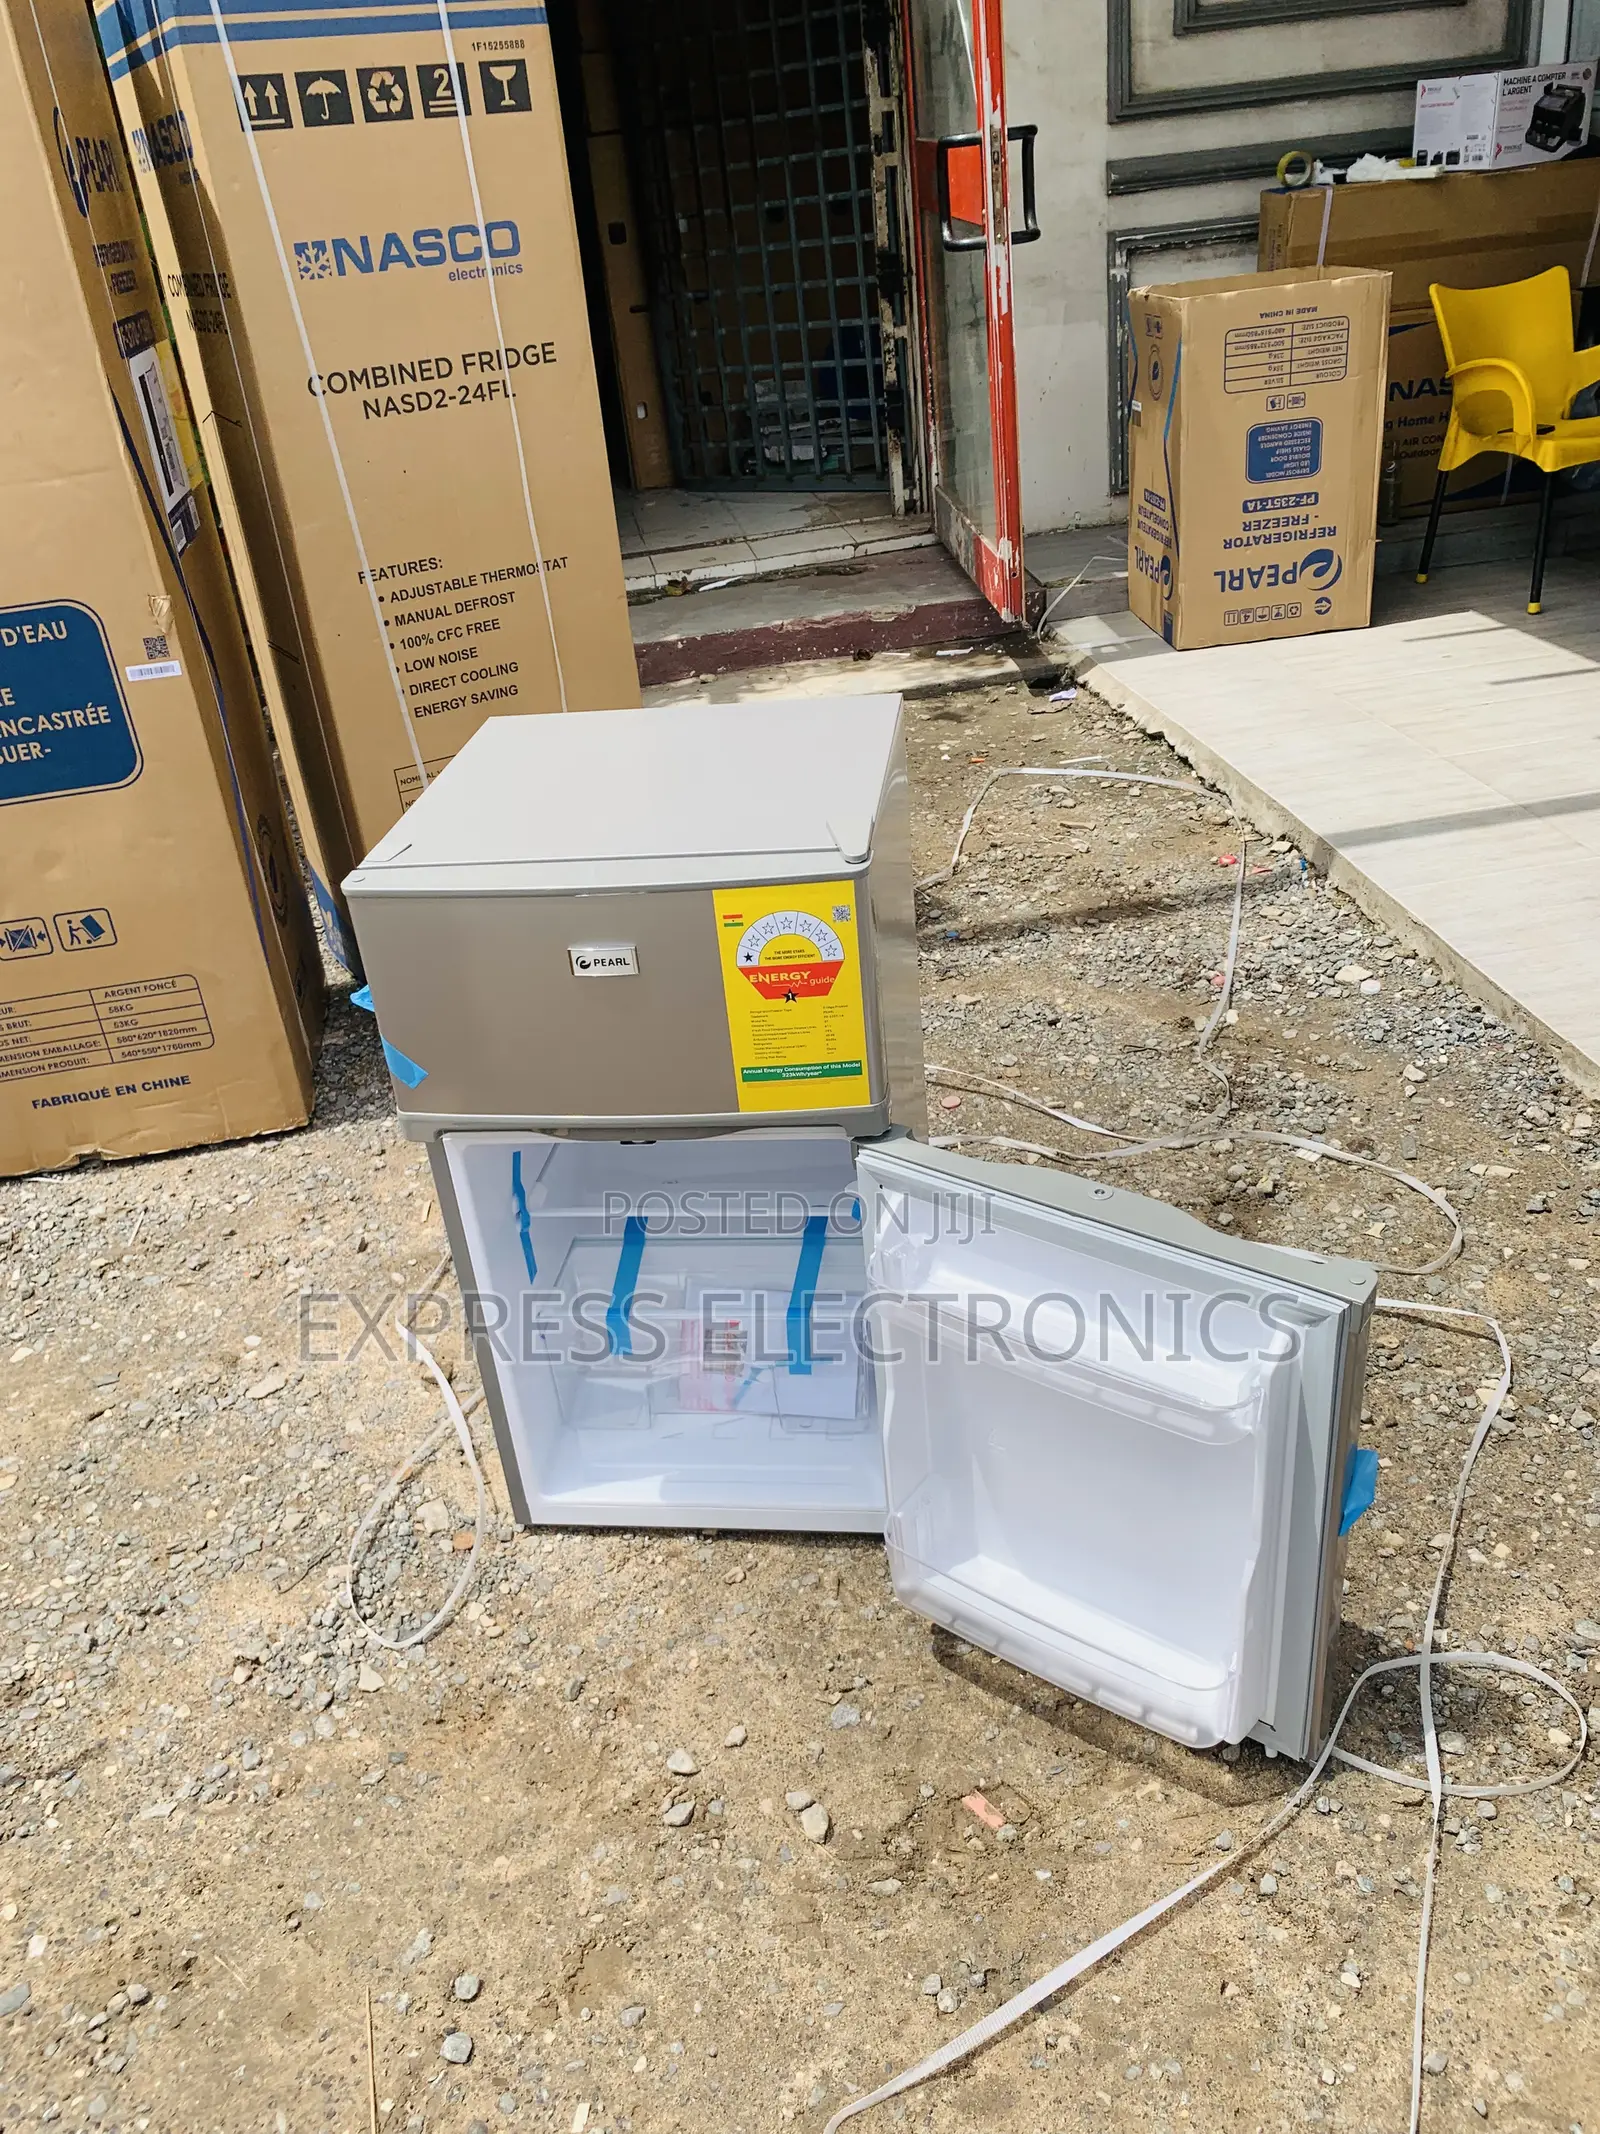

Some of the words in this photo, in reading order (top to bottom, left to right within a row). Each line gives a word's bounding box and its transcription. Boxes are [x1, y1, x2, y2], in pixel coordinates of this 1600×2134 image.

[1503, 75, 1532, 86] MACHINE
[1537, 71, 1567, 82] COMPTER
[332, 219, 522, 277] NASCO
[1259, 311, 1284, 319] CHINA
[1296, 306, 1318, 315] MADE
[307, 357, 454, 399] COMBINED
[461, 341, 558, 377] FRIDGE
[363, 379, 517, 421] NASD2-24FL
[1397, 415, 1435, 428] Home
[1247, 493, 1316, 512] PF-235T-1A
[1242, 513, 1310, 532] FREEZER
[1223, 525, 1338, 550] REFRIGERATOR
[358, 557, 443, 585] FEATURES:
[1135, 545, 1161, 584] PEARL
[1213, 561, 1299, 593] PEARL
[390, 575, 478, 604] ADJUSTABLE
[394, 605, 452, 628] MANUAL
[454, 591, 516, 615] DEFROST
[1, 620, 68, 647] D'EAU
[400, 632, 434, 650] 100%
[436, 626, 464, 642] CFC
[466, 618, 501, 636] FREE
[404, 656, 436, 674] LOW
[438, 647, 479, 666] NOISE
[409, 675, 457, 697] DIRECT
[460, 661, 520, 685] COOLING
[414, 696, 467, 719] ENERGY
[470, 684, 519, 705] SAVING
[0, 702, 112, 740] NCASTRÉE
[593, 957, 631, 969] PEARL
[104, 986, 141, 999] ARGENT
[144, 978, 178, 992] FONCÉ
[750, 970, 811, 985] ENERGY
[809, 976, 836, 987] guide
[6, 1020, 32, 1030] BRUT:
[48, 1057, 90, 1071] PRODUIT:
[784, 1065, 823, 1073] Consumption
[32, 1086, 111, 1110] FABRIQUÉ
[115, 1083, 137, 1096] EN
[141, 1075, 191, 1092] CHINE
